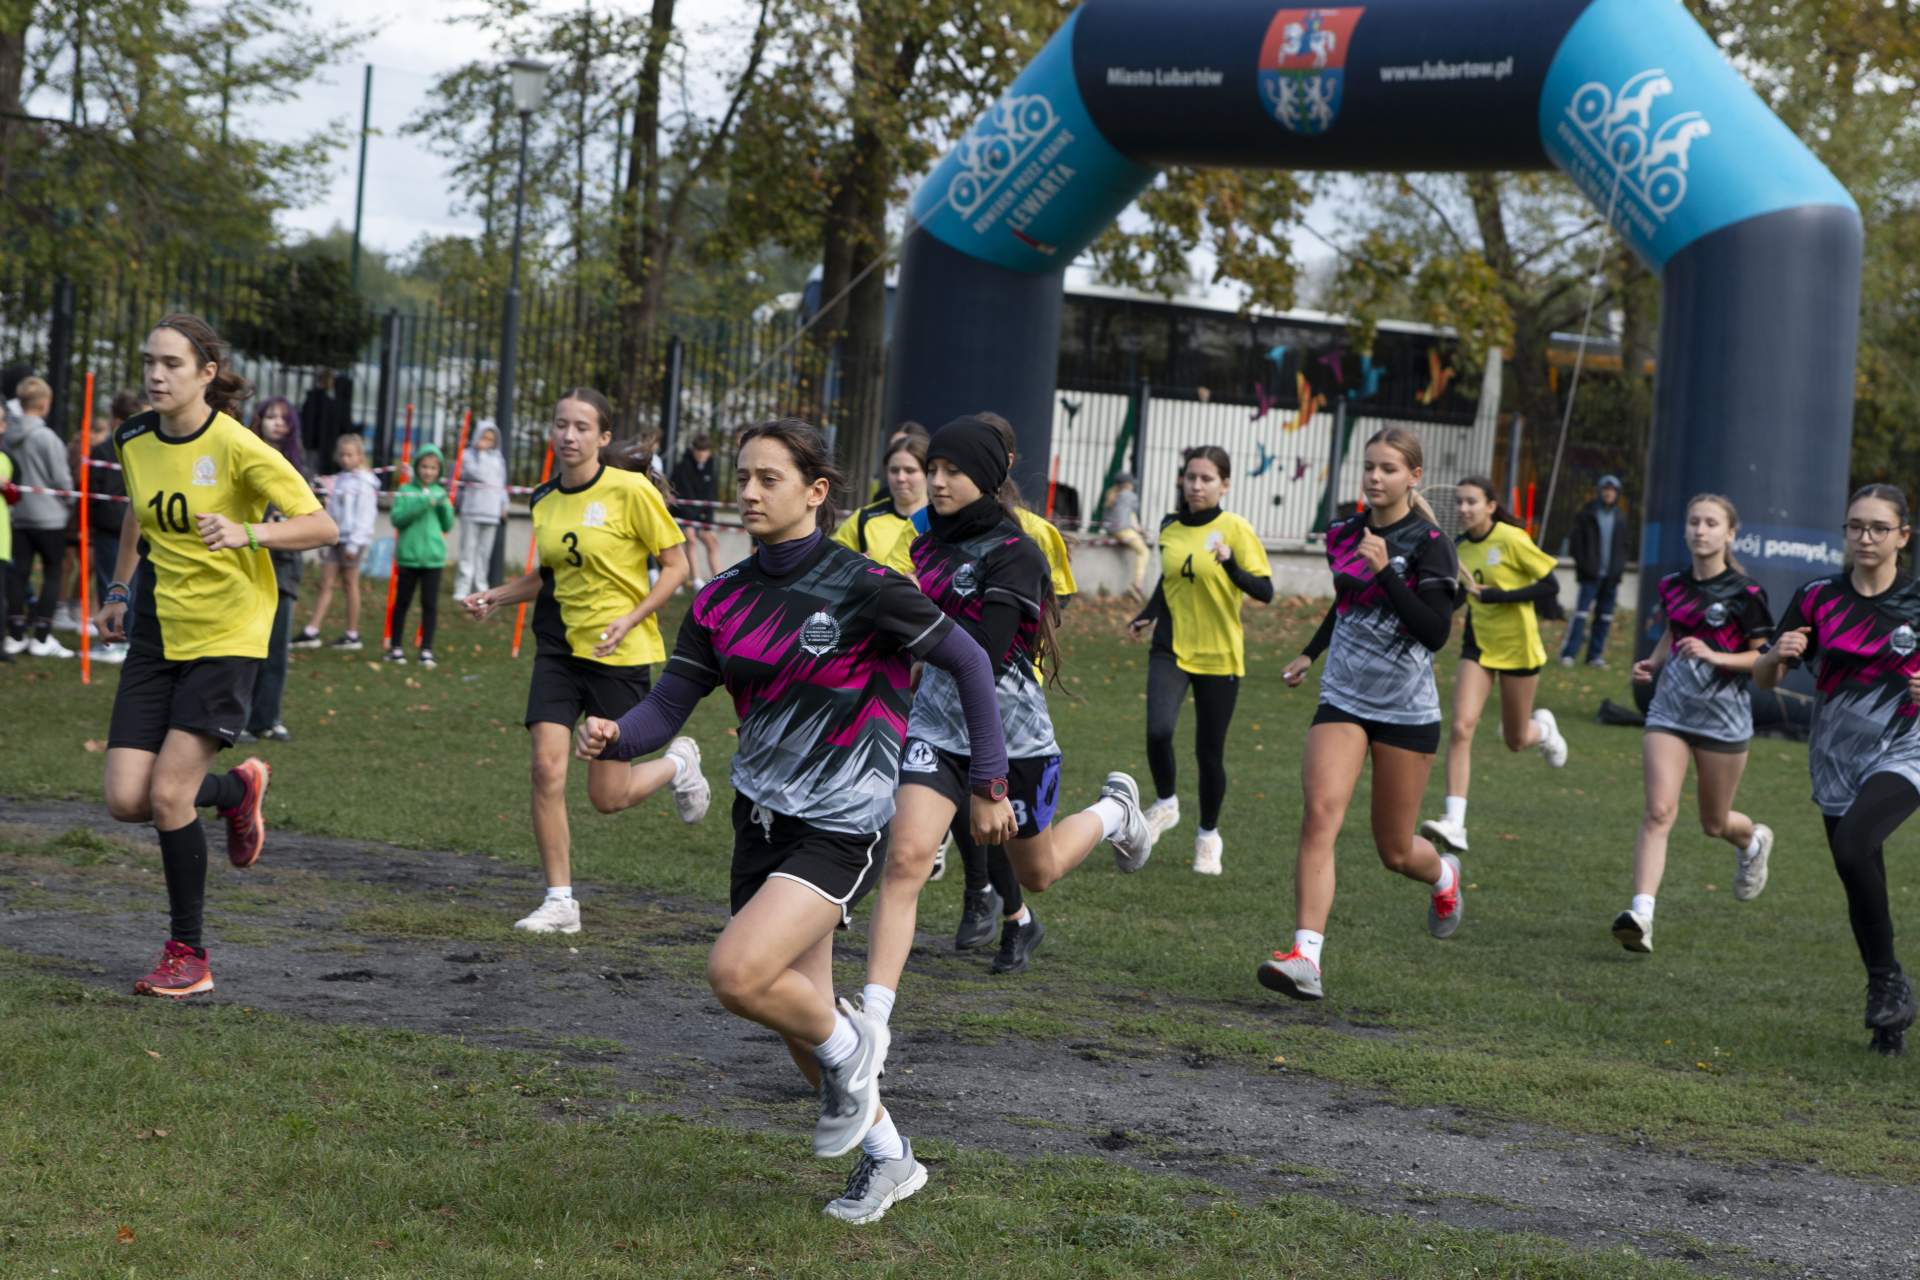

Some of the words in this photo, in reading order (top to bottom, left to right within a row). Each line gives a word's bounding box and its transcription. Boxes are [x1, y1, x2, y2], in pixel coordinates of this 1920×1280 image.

[1106, 67, 1154, 86] Miasto
[1380, 56, 1514, 82] www.lubartow.pl
[1006, 163, 1076, 231] LEWARTA
[148, 490, 190, 534] 10
[562, 531, 583, 568] 3
[1181, 552, 1196, 585] 4
